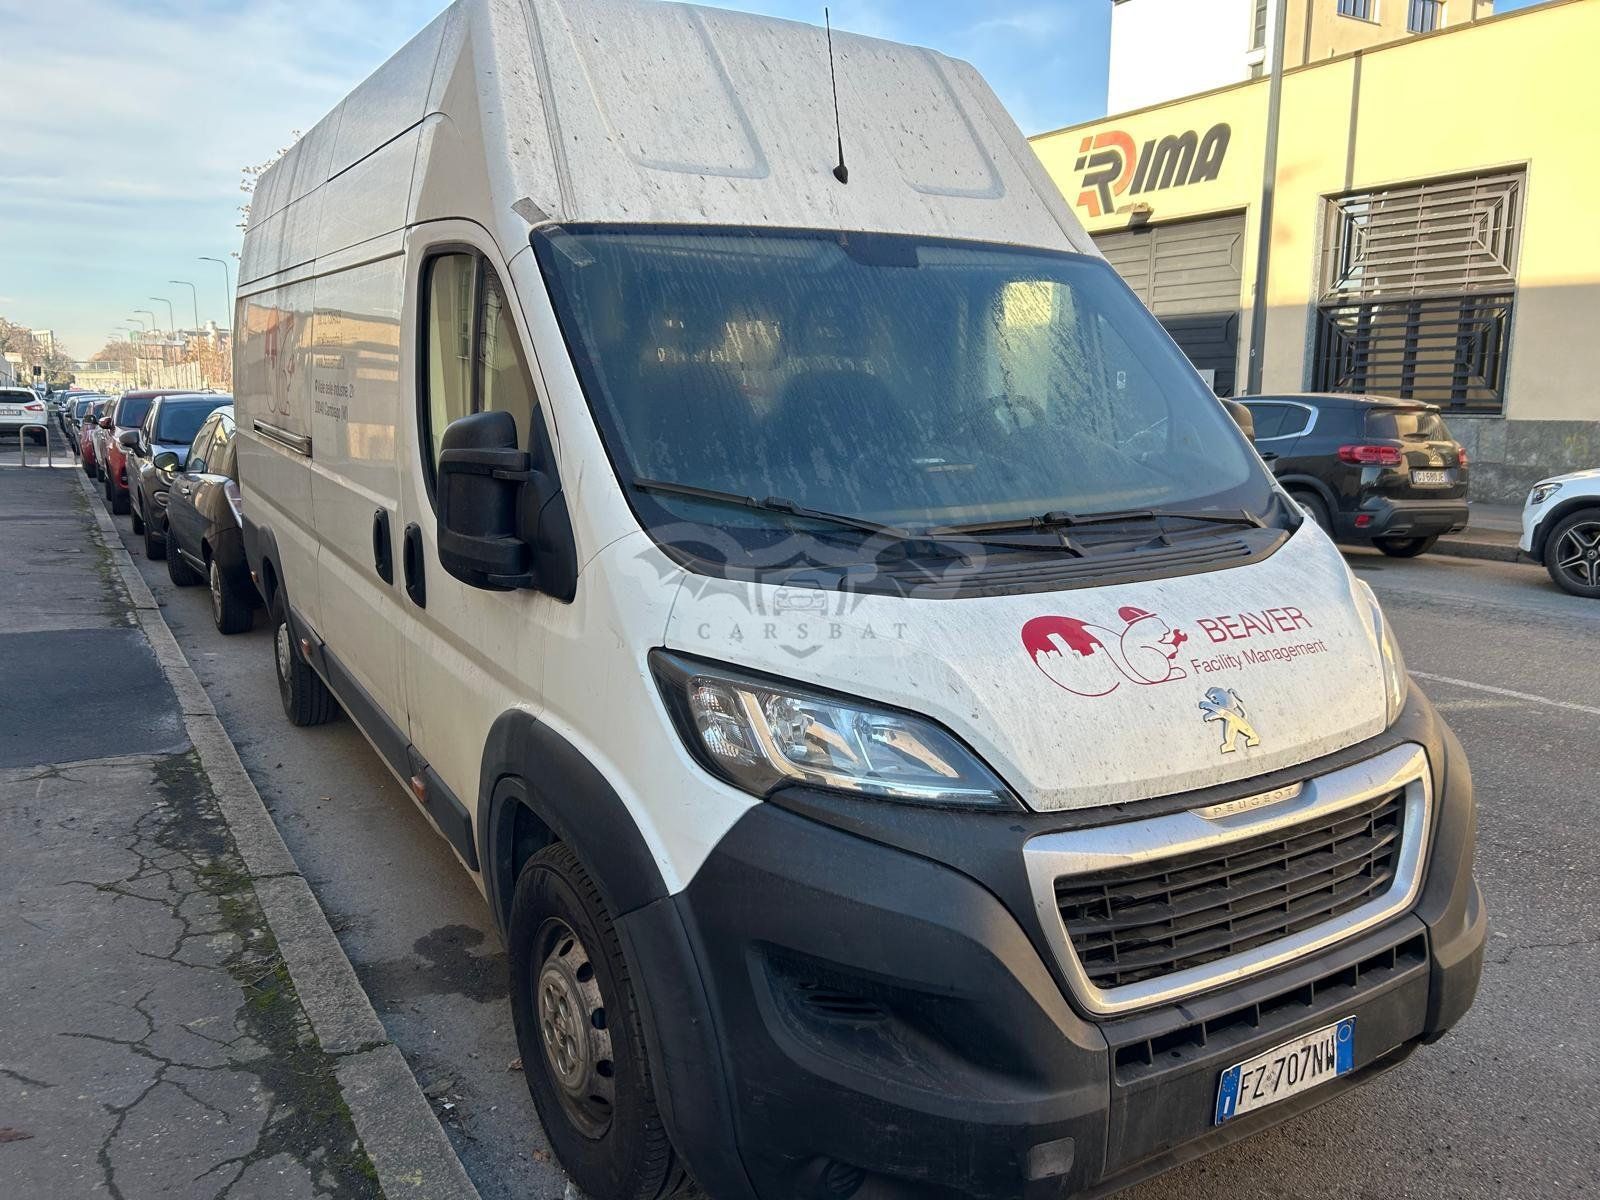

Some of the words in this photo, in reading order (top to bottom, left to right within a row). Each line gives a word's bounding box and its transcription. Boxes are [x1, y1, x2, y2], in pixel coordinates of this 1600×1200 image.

[1196, 606, 1313, 643] BEAVER
[1190, 653, 1243, 675] Facility
[1241, 639, 1328, 665] Management
[1213, 787, 1293, 815] PEUGEOT
